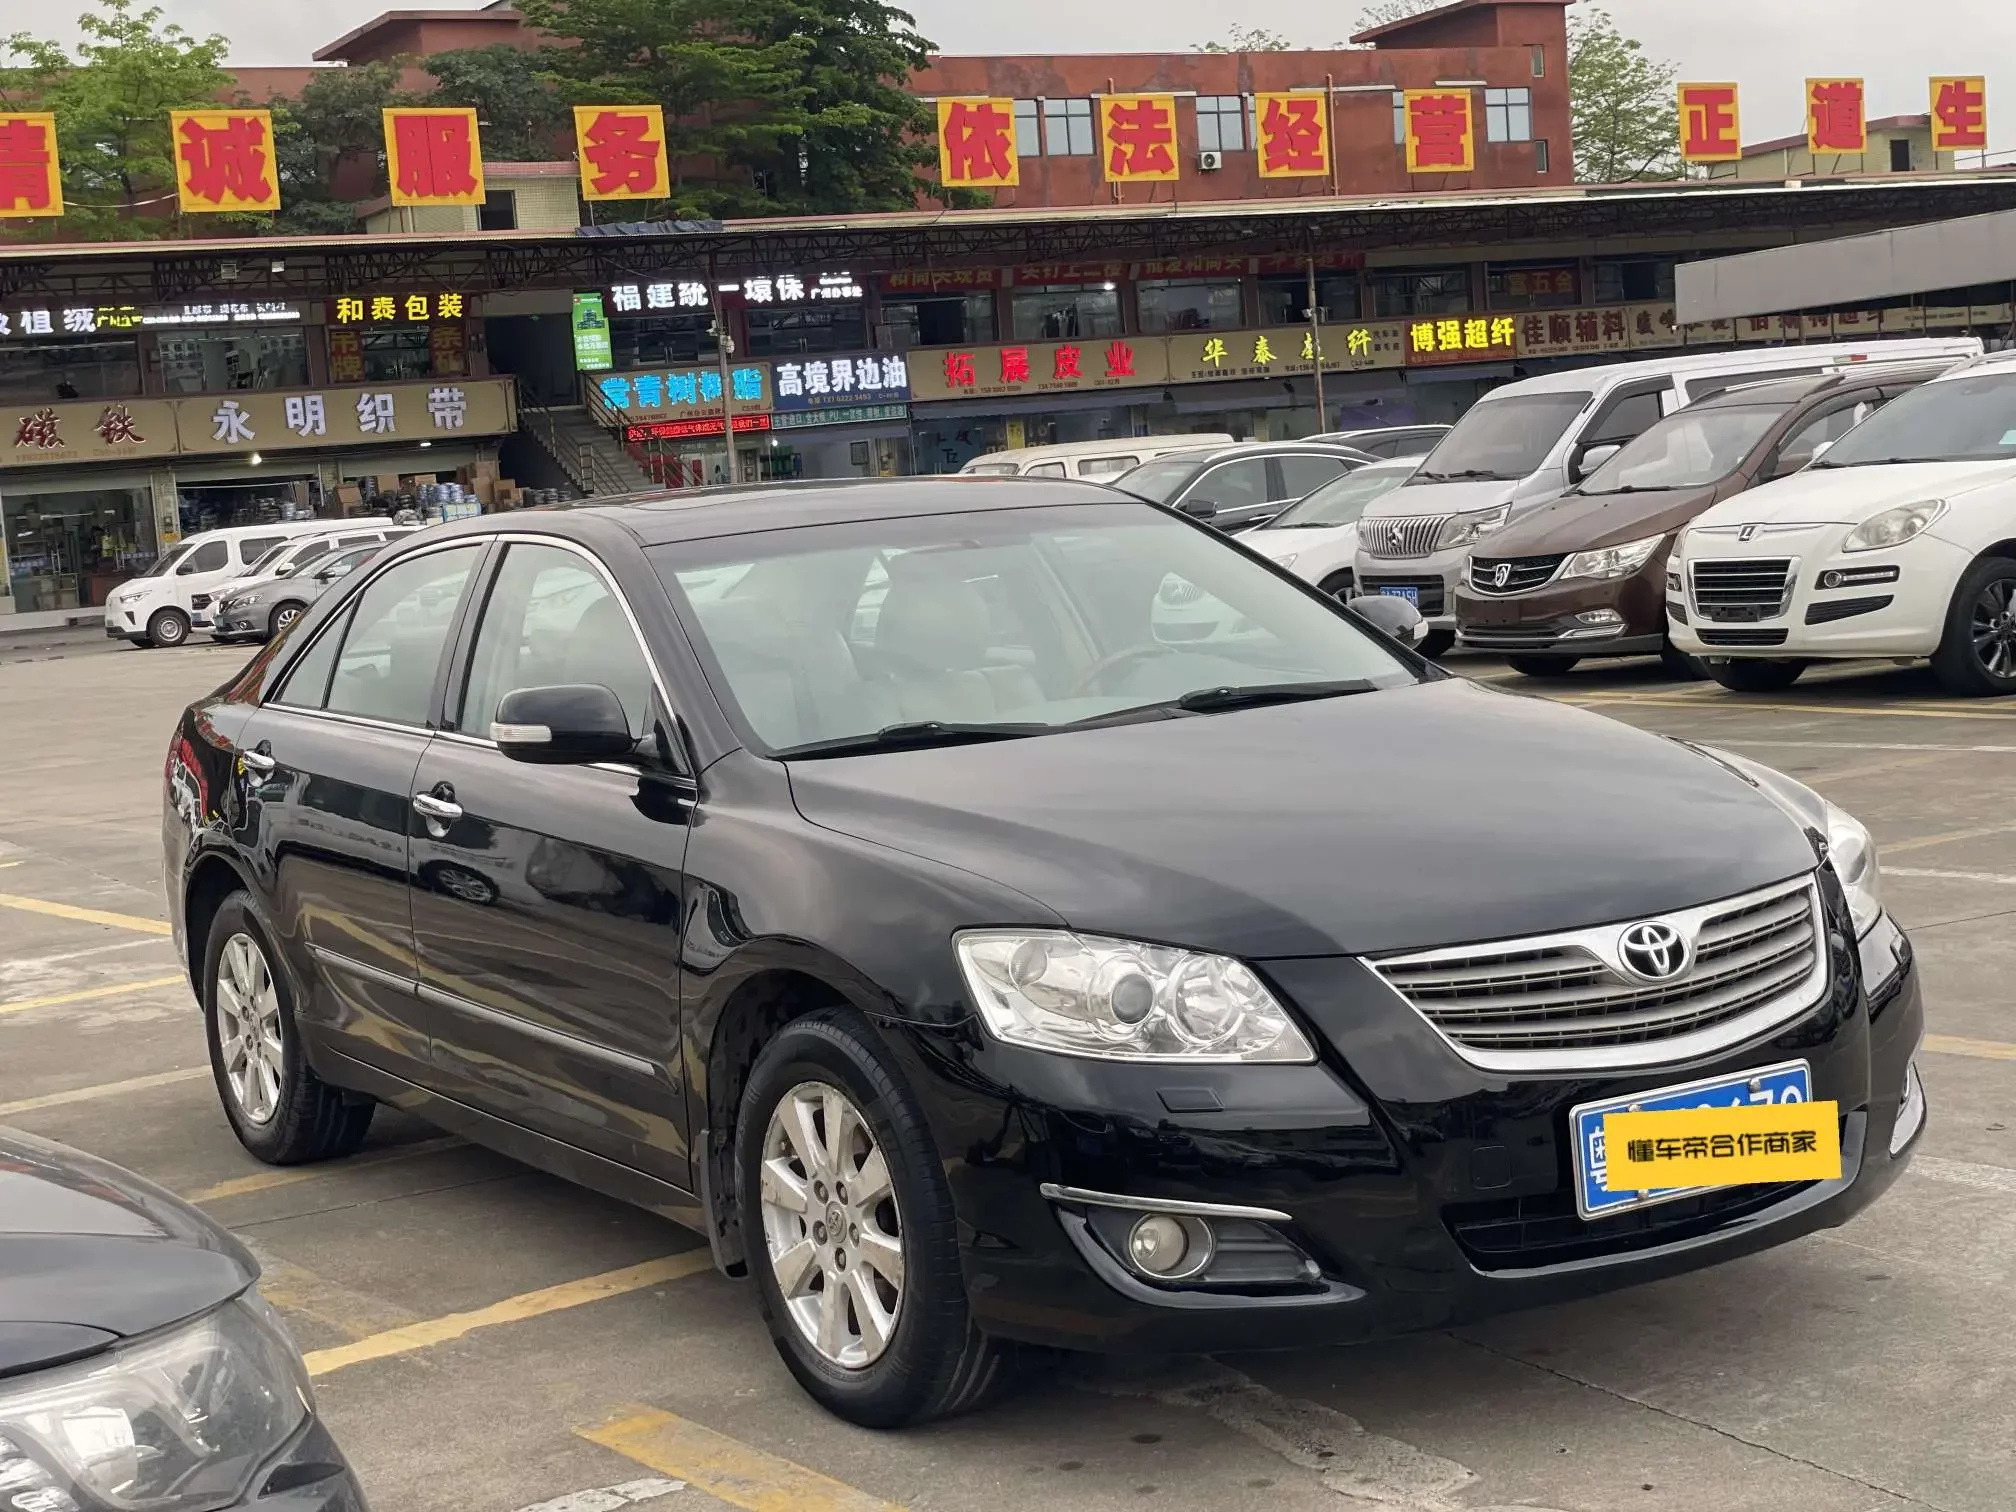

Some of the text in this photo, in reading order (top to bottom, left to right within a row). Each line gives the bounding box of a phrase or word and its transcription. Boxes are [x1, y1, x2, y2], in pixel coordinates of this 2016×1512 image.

[337, 293, 463, 324] 和泰包装
[1522, 310, 1626, 347] 佳顺辅料
[331, 332, 363, 380] 吊牌
[1410, 318, 1515, 353] 博强超纤
[776, 355, 907, 397] 高境界边油
[945, 341, 1136, 387] 拓展皮业
[14, 404, 146, 449] 磁铁
[213, 387, 468, 444] 永明织带
